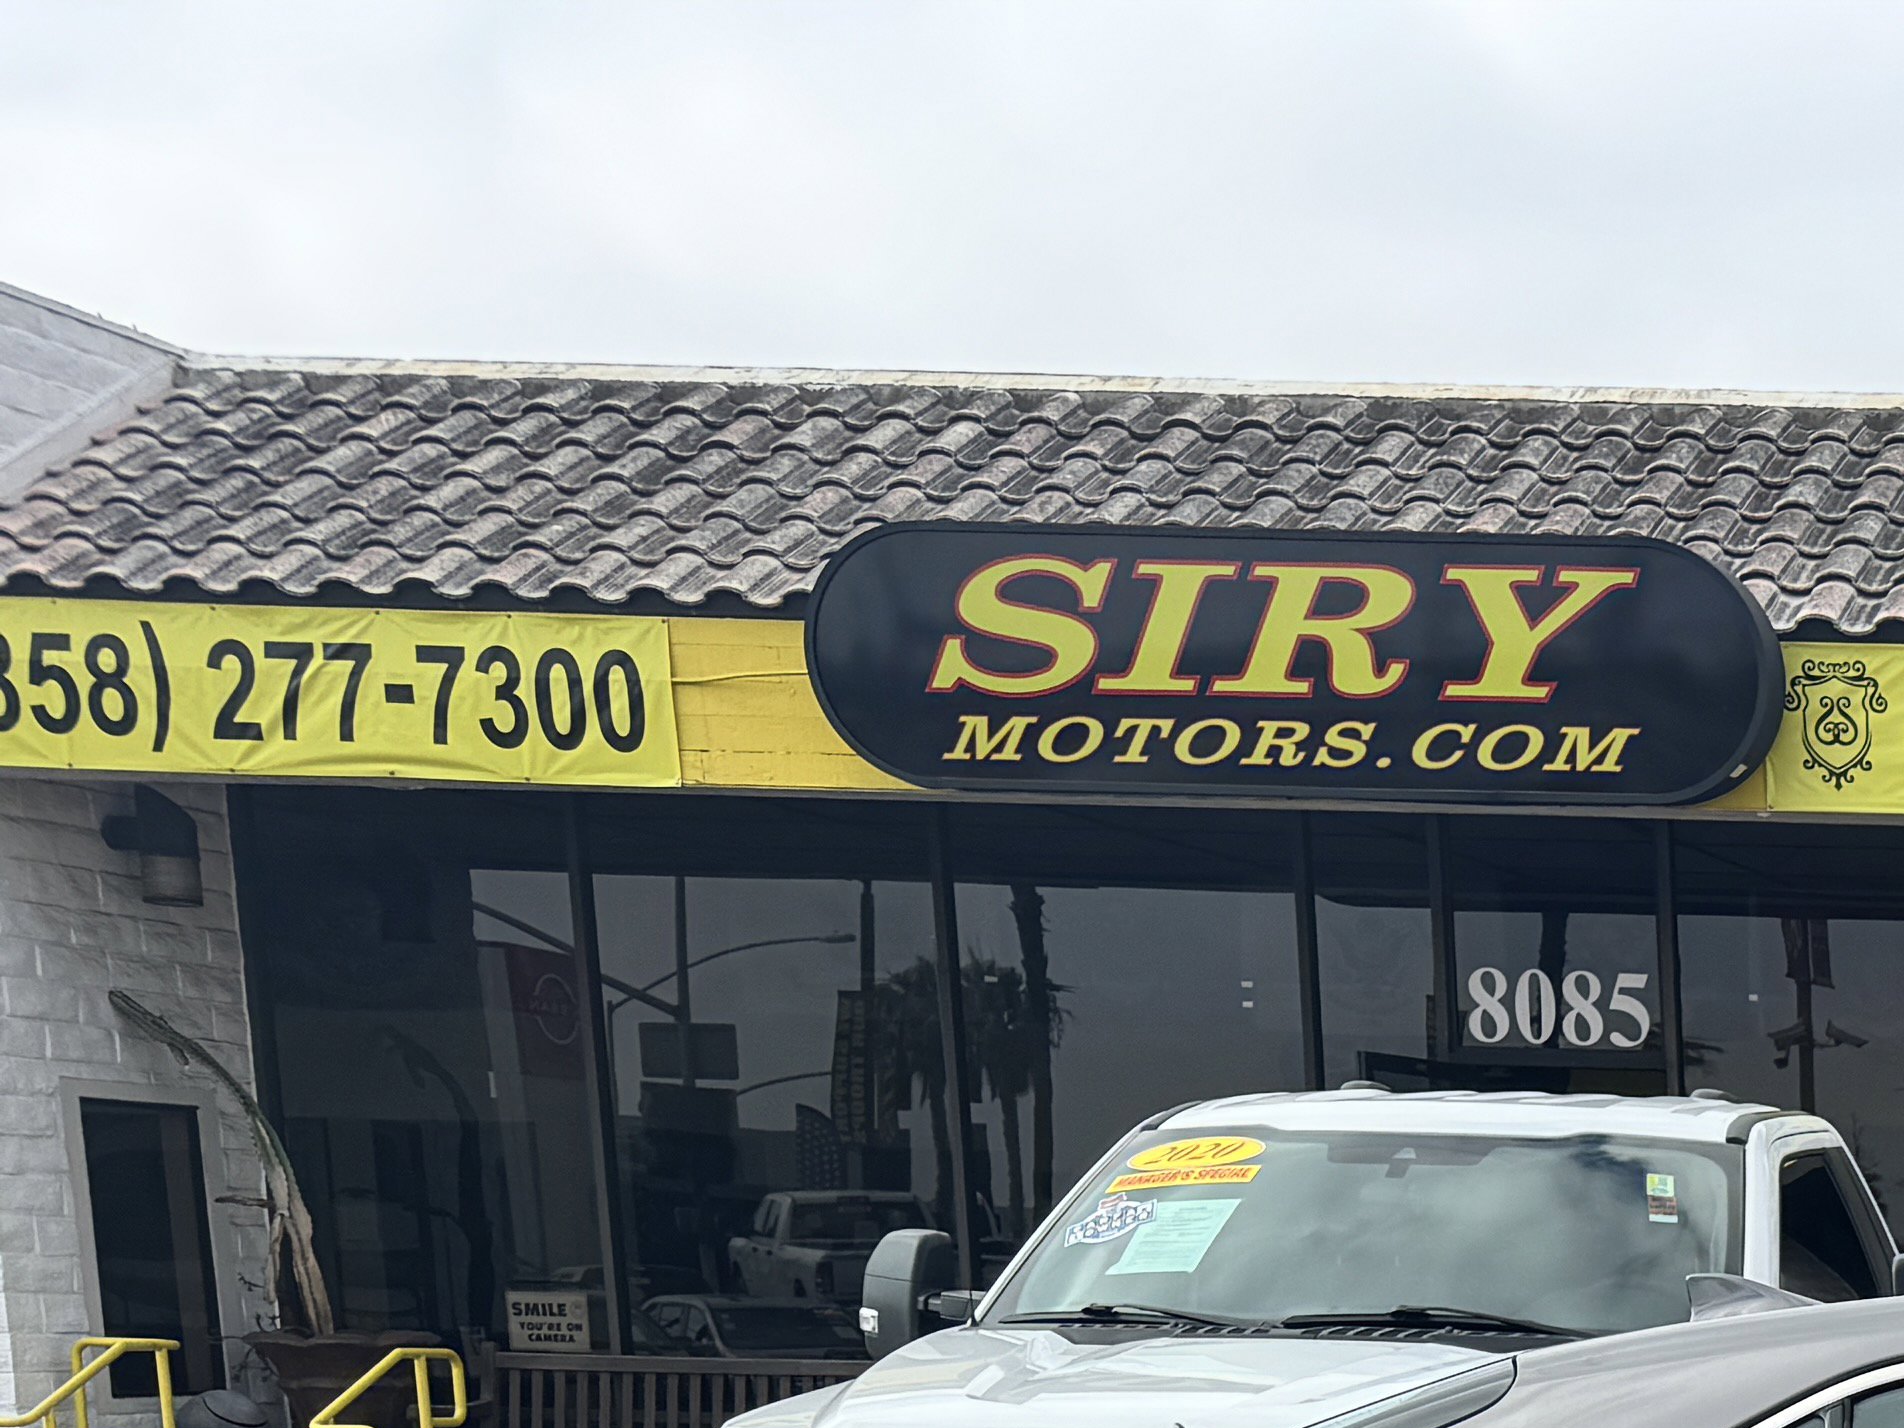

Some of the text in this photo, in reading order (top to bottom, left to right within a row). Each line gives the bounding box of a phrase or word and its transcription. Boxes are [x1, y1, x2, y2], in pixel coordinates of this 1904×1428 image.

[926, 553, 1640, 704] SIRY
[206, 638, 646, 753] 277-7300
[942, 715, 1640, 773] MOTORS.COM
[1466, 966, 1651, 1049] 8085
[511, 1302, 567, 1317] SMILE
[519, 1321, 583, 1332] YOU'RE ON
[528, 1333, 576, 1343] CAMERA
